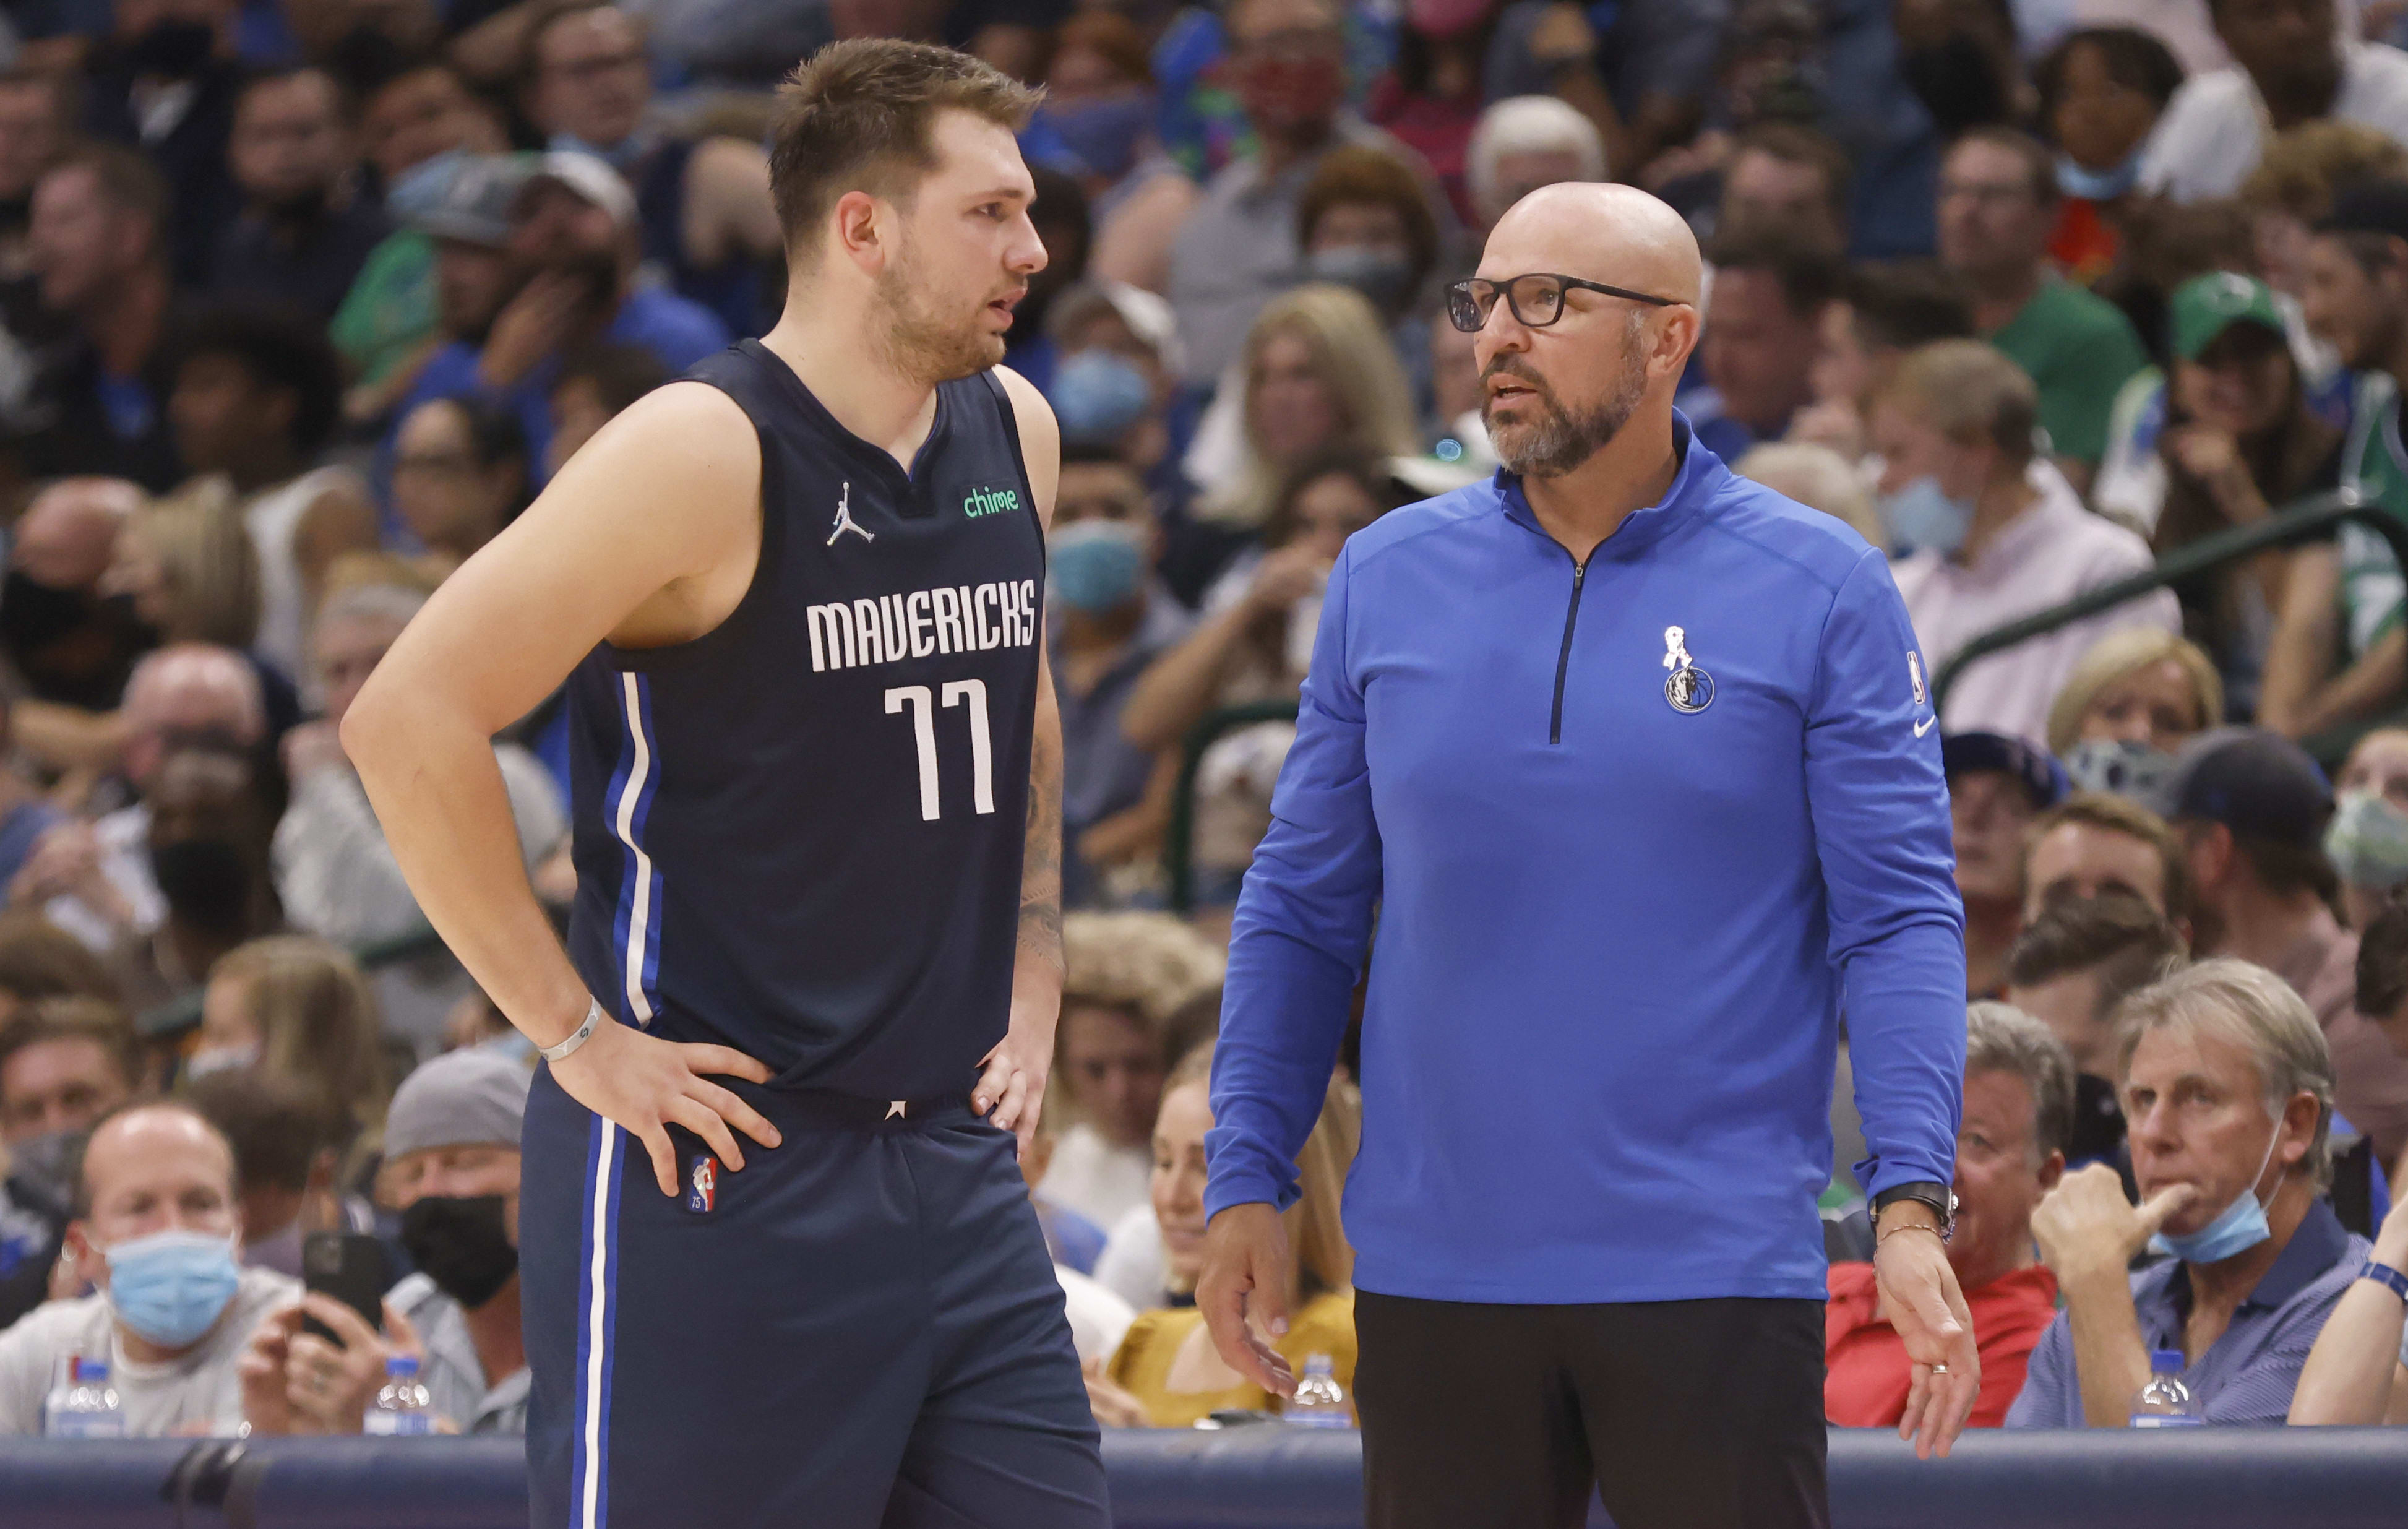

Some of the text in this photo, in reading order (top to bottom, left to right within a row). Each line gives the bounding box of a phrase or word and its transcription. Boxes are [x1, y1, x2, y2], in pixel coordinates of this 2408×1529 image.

[964, 486, 1019, 518] chime
[806, 579, 1034, 673] MAVERICKS
[884, 678, 995, 821] 77
[692, 1196, 700, 1208] 75
